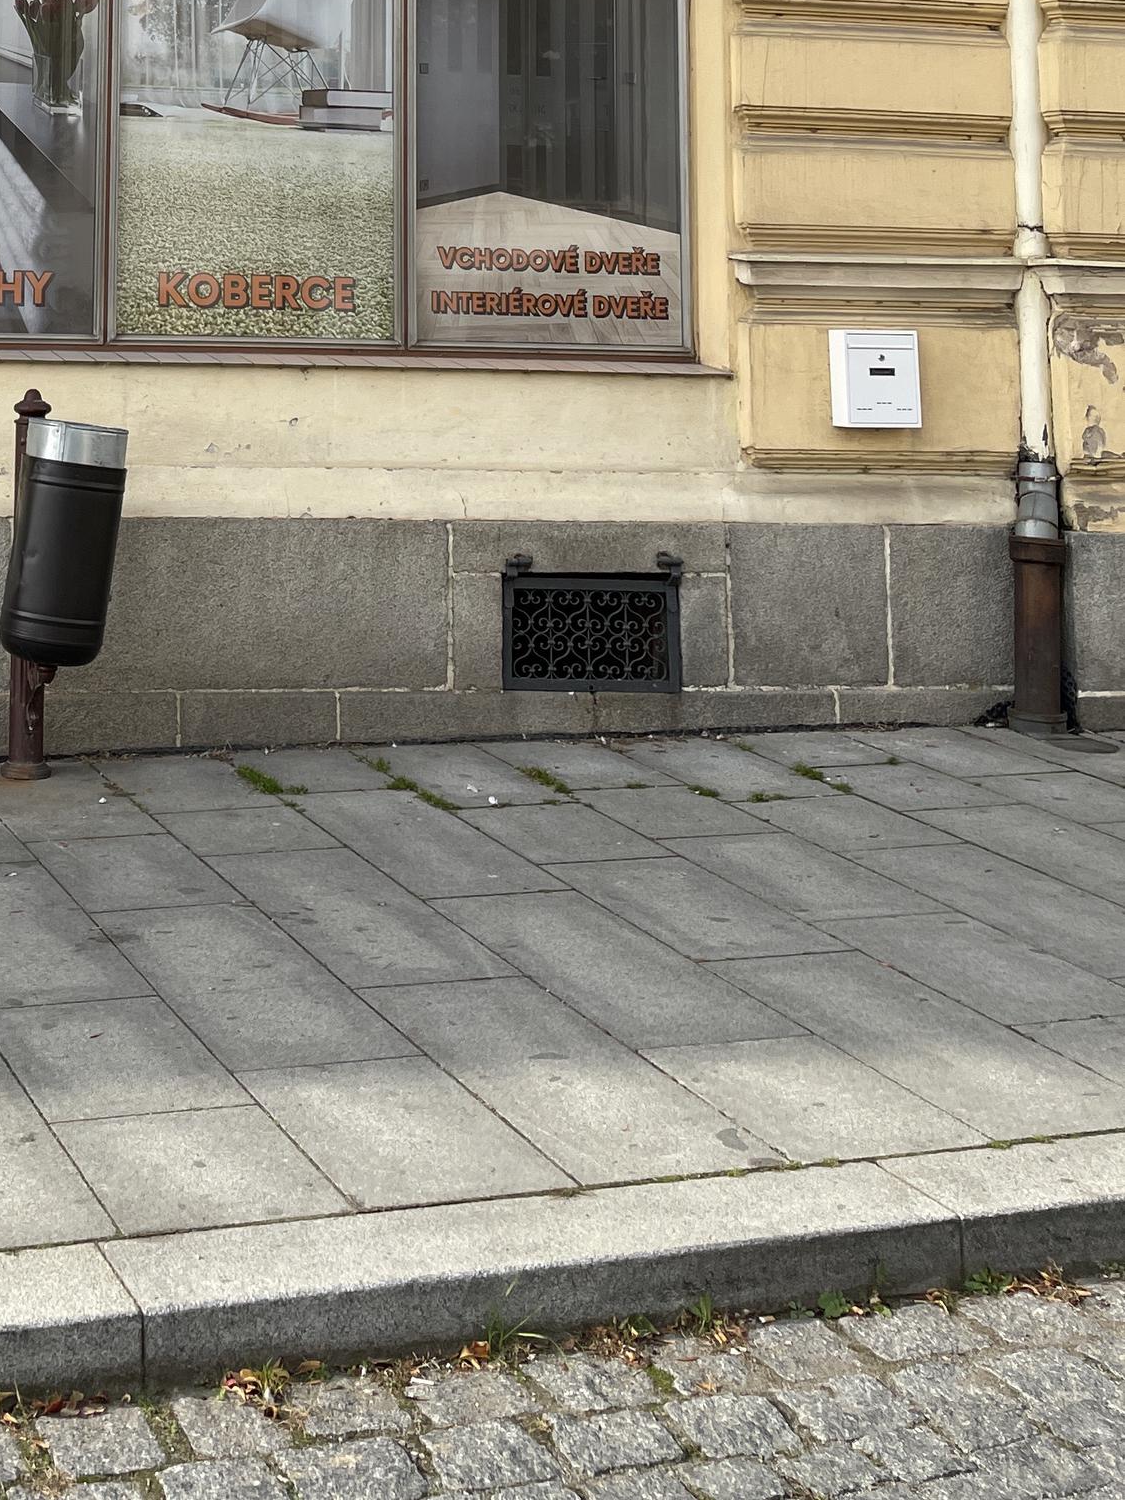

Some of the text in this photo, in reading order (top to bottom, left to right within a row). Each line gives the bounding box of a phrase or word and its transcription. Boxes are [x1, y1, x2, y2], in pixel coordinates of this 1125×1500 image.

[437, 245, 660, 276] VCHODOVÉ DVEŘE
[157, 271, 357, 312] KOBERCE
[431, 287, 669, 320] INTERIÉROVÉ DVEŘE
